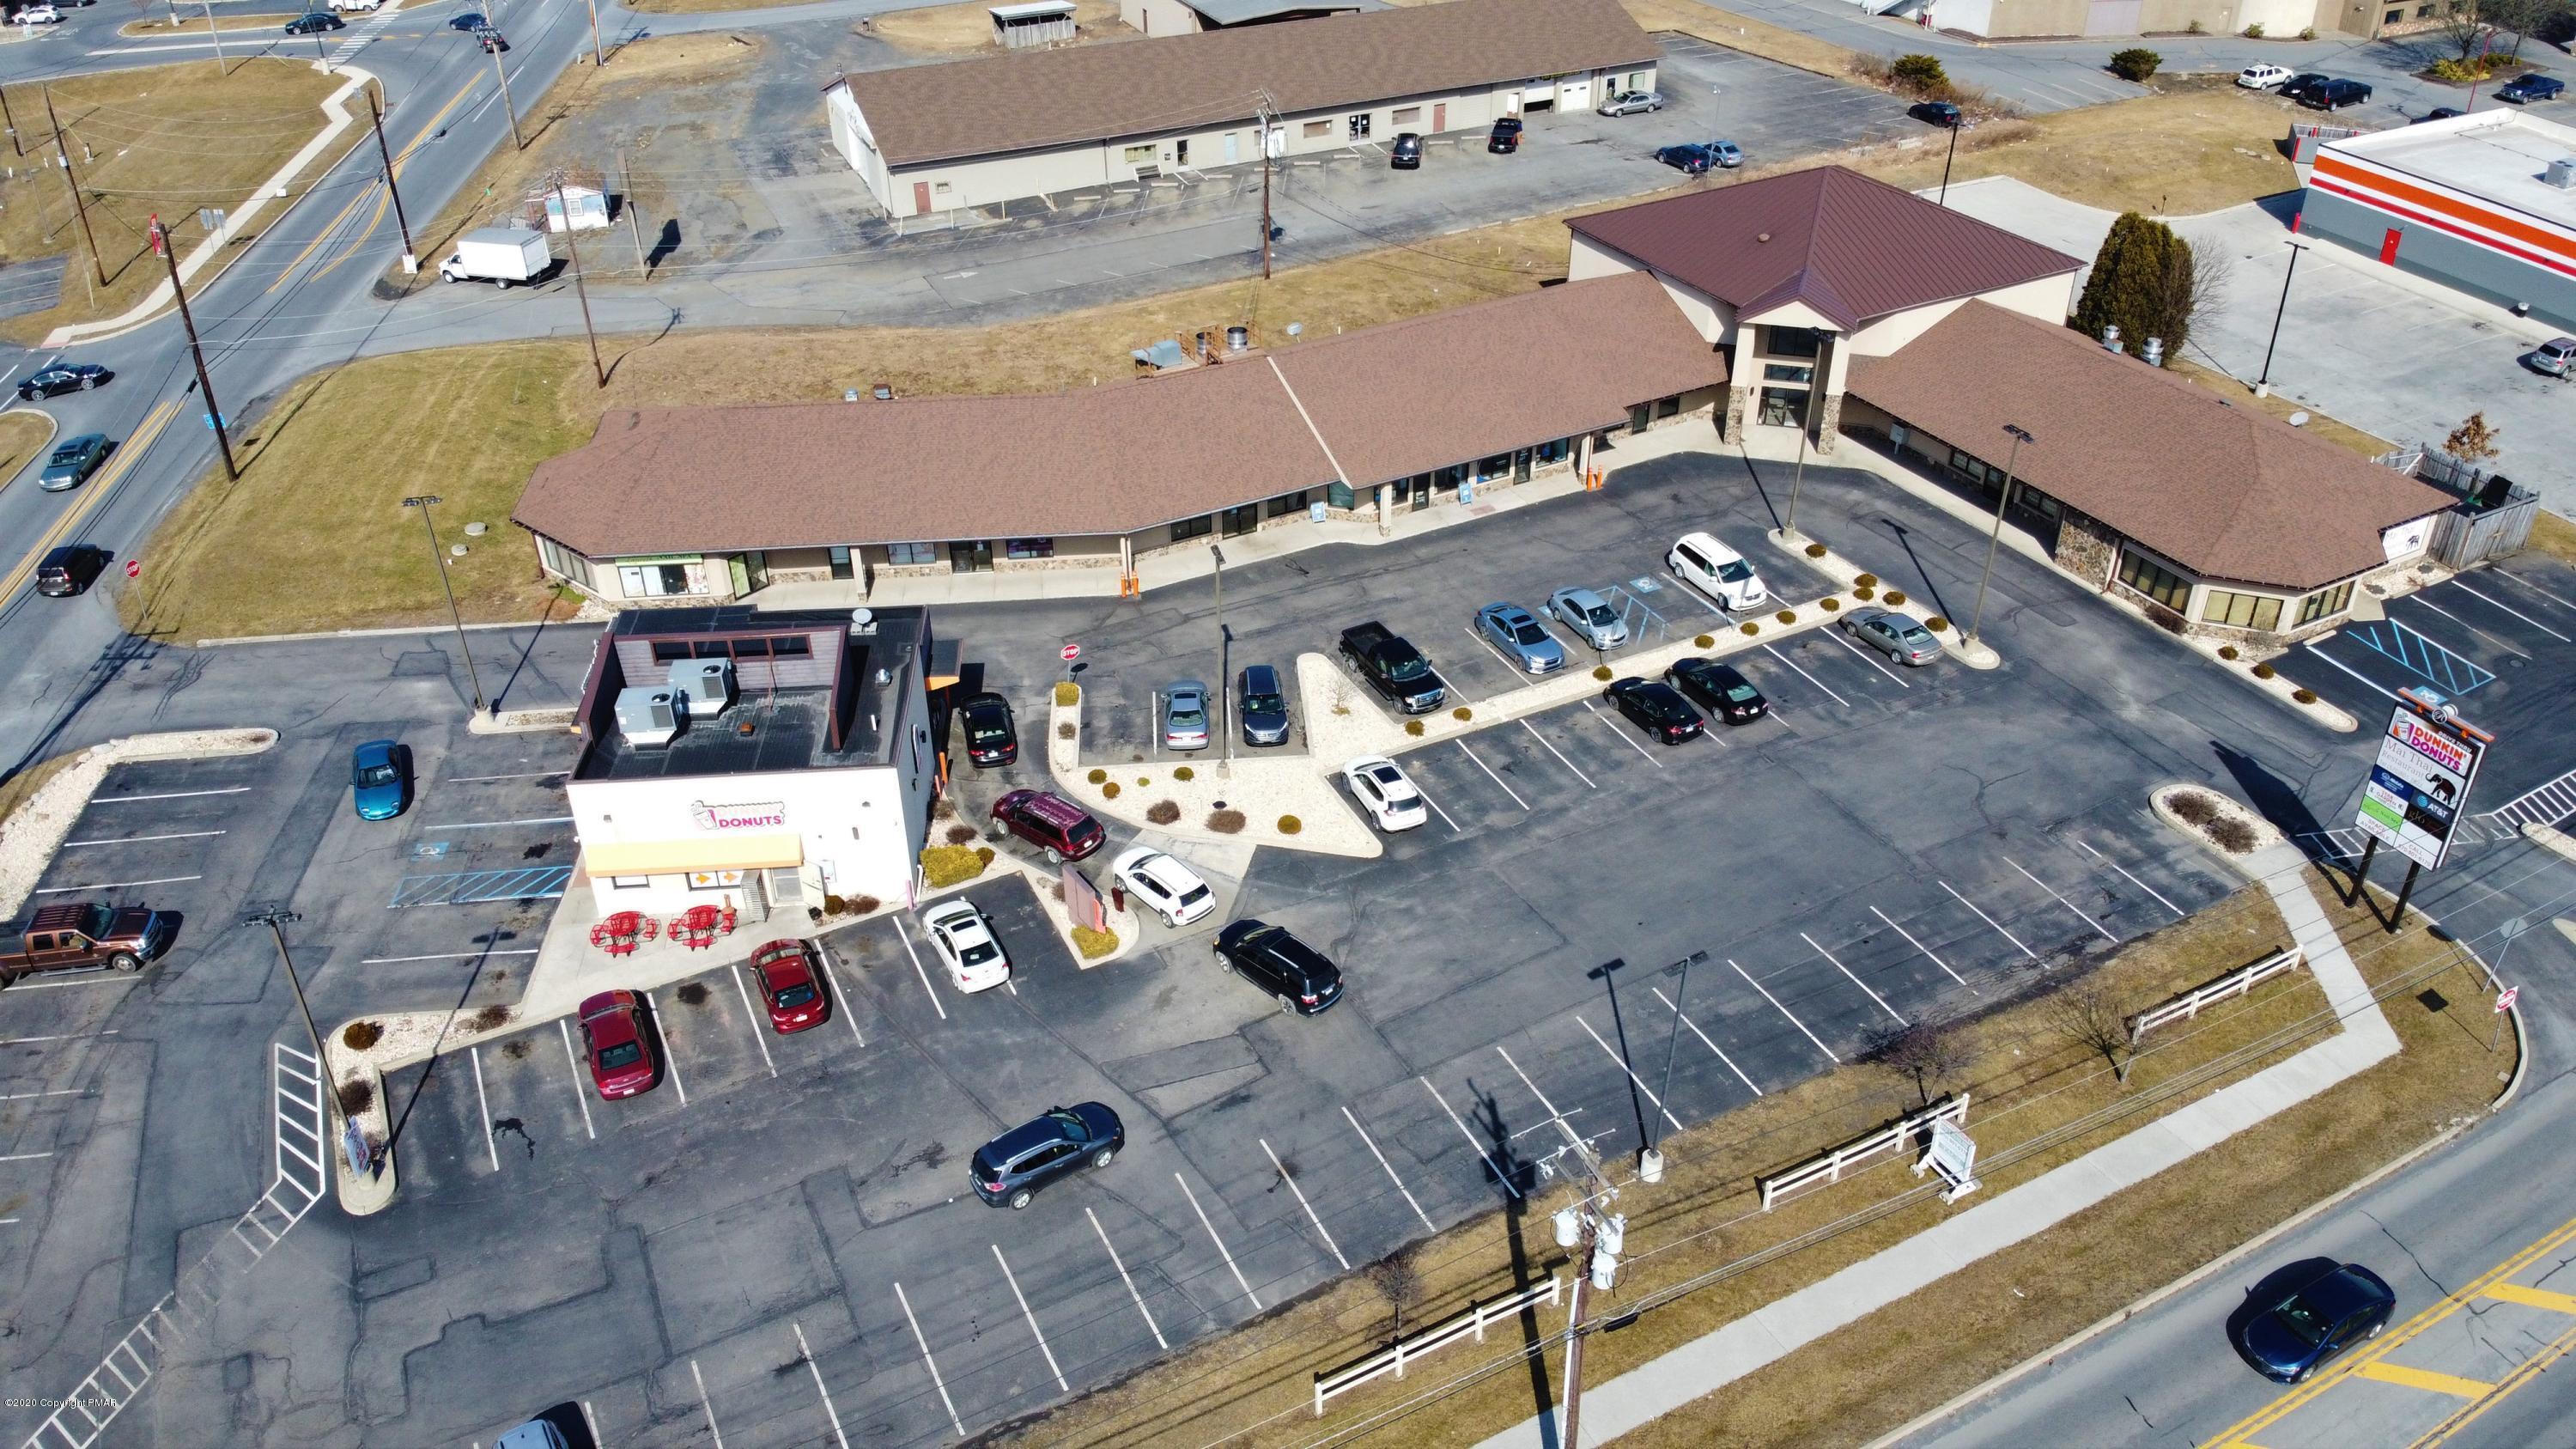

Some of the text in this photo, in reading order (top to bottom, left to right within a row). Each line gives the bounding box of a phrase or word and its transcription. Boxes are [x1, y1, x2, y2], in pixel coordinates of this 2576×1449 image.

[2411, 736, 2461, 770] DONUTS
[2415, 727, 2467, 761] DUNKIN'
[2439, 731, 2472, 752] DRIVE THRU
[2381, 751, 2424, 778] Restaurant
[2385, 739, 2406, 757] Mai
[2409, 751, 2433, 773] Thai
[718, 815, 782, 828] DONUTS
[2427, 803, 2449, 819] AT&T
